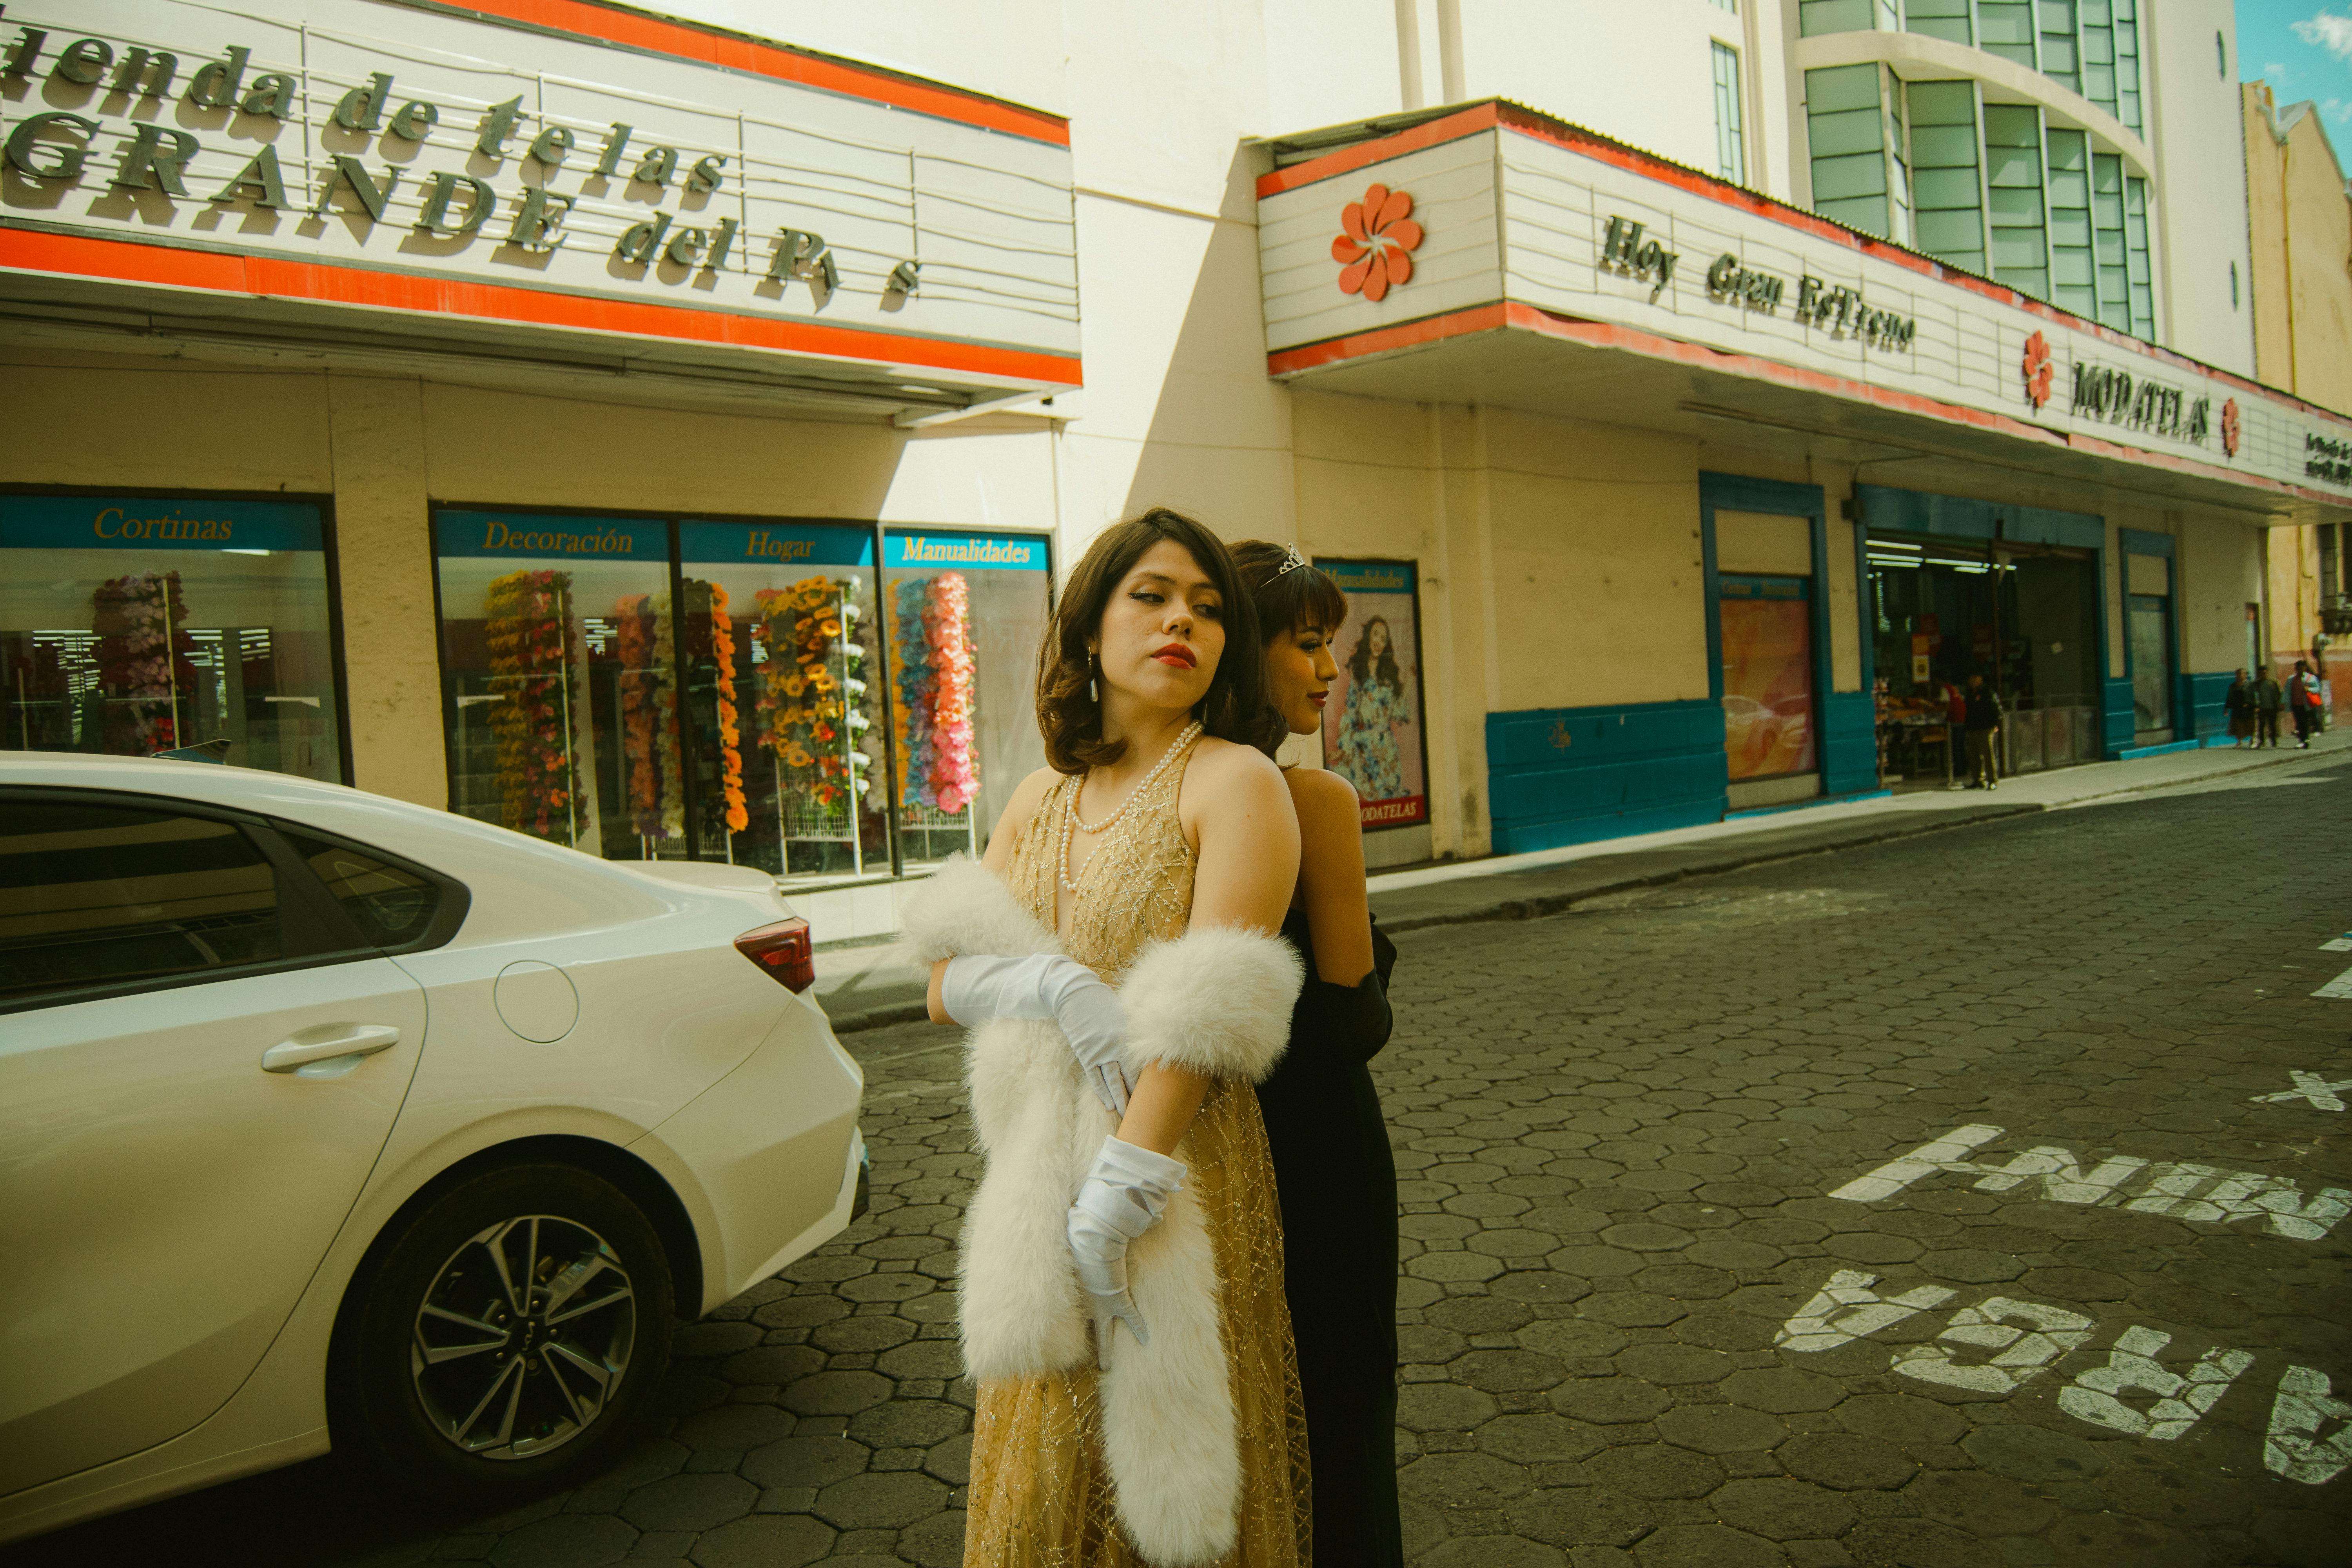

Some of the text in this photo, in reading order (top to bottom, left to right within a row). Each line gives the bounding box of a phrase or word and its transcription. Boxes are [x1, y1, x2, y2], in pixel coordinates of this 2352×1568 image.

[335, 72, 439, 140] de
[477, 94, 727, 193] telas
[6, 112, 577, 248] GRANDE
[617, 211, 739, 270] del
[1604, 214, 1680, 292] Hoy
[1709, 253, 1784, 306] Gran
[2074, 360, 2210, 438] MODATELAS
[94, 507, 232, 540] Cortinas
[482, 521, 633, 554] Decoración
[746, 530, 816, 563] Hogar
[902, 536, 1031, 563] Manualidades
[1360, 801, 1417, 822] ODATELAS
